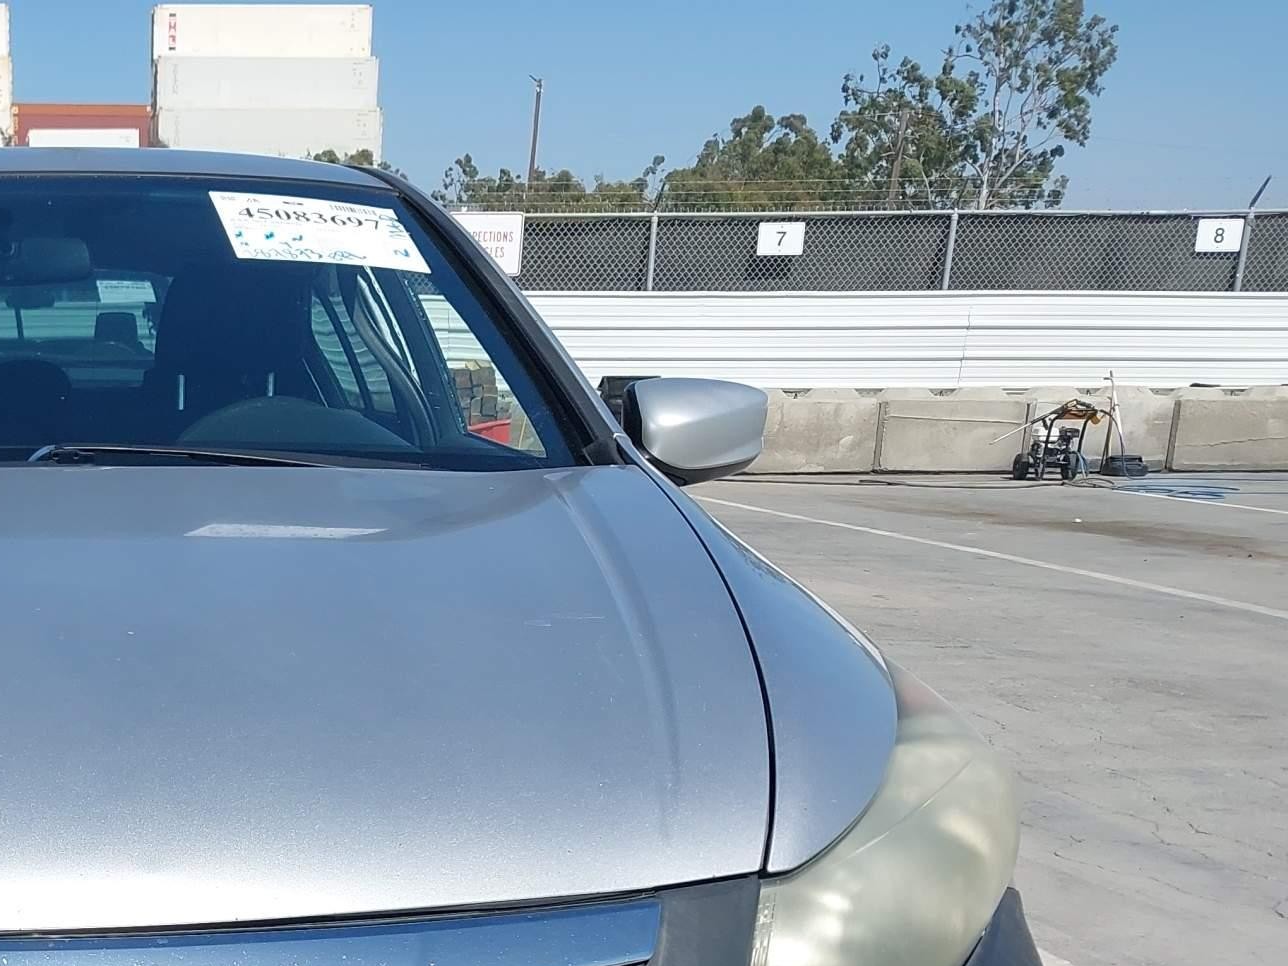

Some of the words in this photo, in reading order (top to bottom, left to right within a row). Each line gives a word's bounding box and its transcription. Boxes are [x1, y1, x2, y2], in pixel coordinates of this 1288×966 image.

[238, 207, 379, 230] 45083697
[776, 231, 787, 247] 7
[1214, 227, 1225, 244] 8
